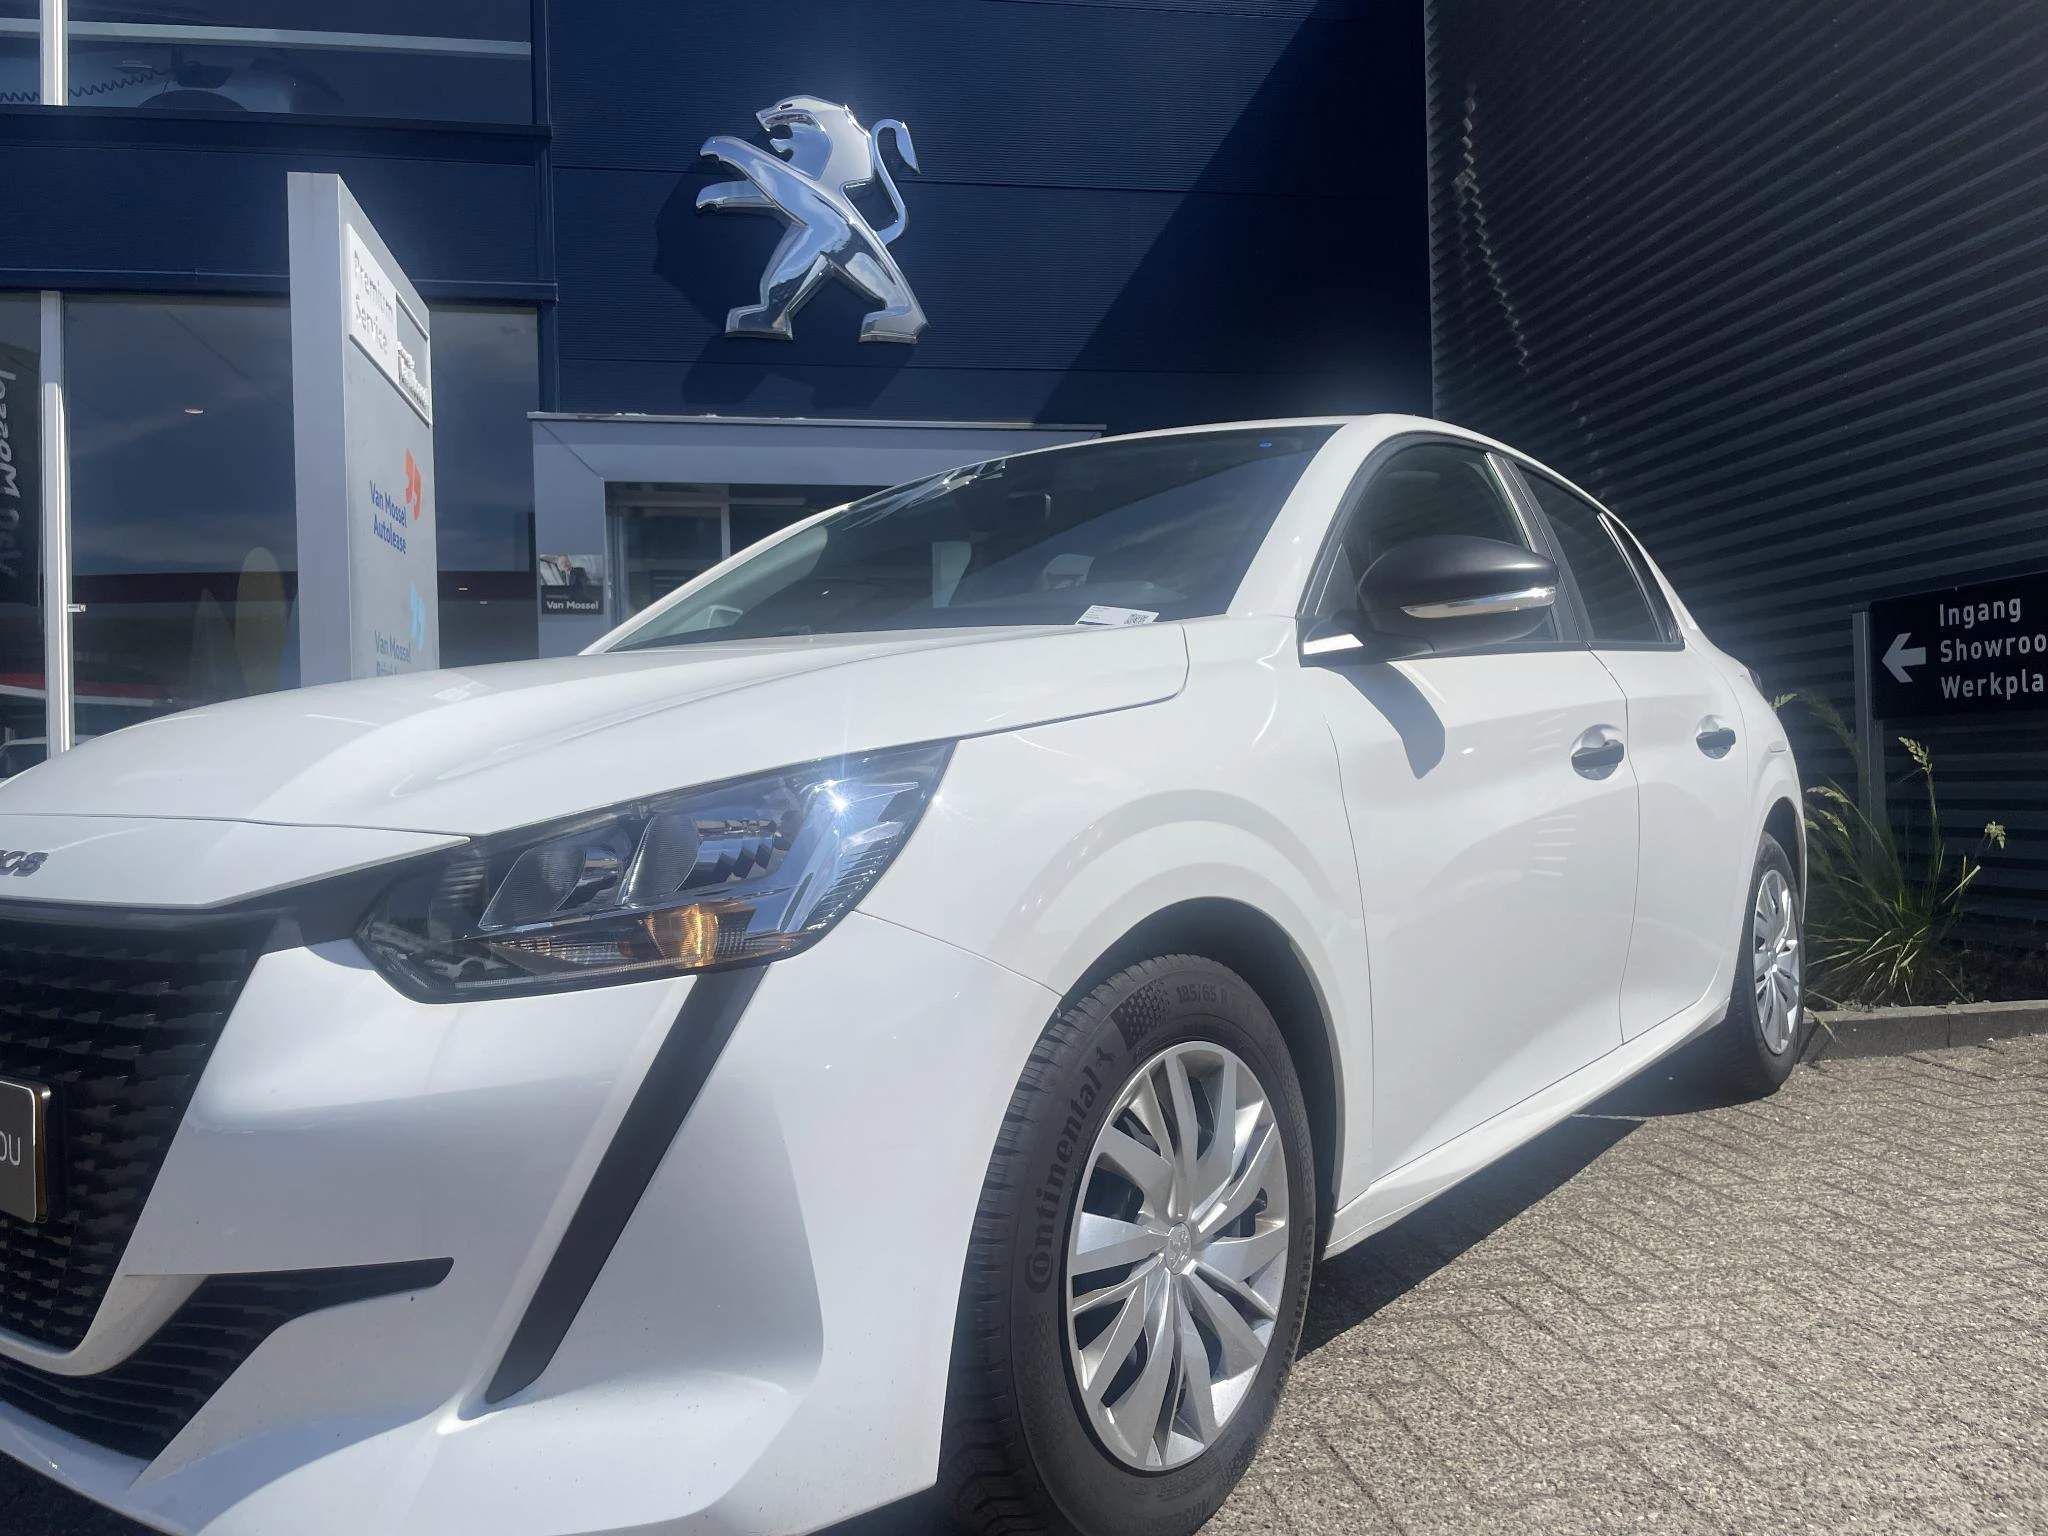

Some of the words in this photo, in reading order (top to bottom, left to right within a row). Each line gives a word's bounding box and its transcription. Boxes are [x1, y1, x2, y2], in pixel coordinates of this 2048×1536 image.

[354, 250, 393, 321] Premium
[355, 294, 388, 355] Service
[370, 480, 384, 511] Van
[385, 492, 407, 528] Mossel
[374, 514, 406, 555] Autolease
[546, 600, 564, 609] Van
[566, 600, 599, 610] Mossel
[1940, 598, 2020, 629] Ingang
[374, 629, 389, 656] Van
[390, 632, 412, 664] Mossel
[1940, 634, 2047, 662] Showroo
[1940, 669, 2044, 700] Werkpla
[1175, 983, 1217, 1004] 185/65
[1025, 1066, 1102, 1294] Continental
